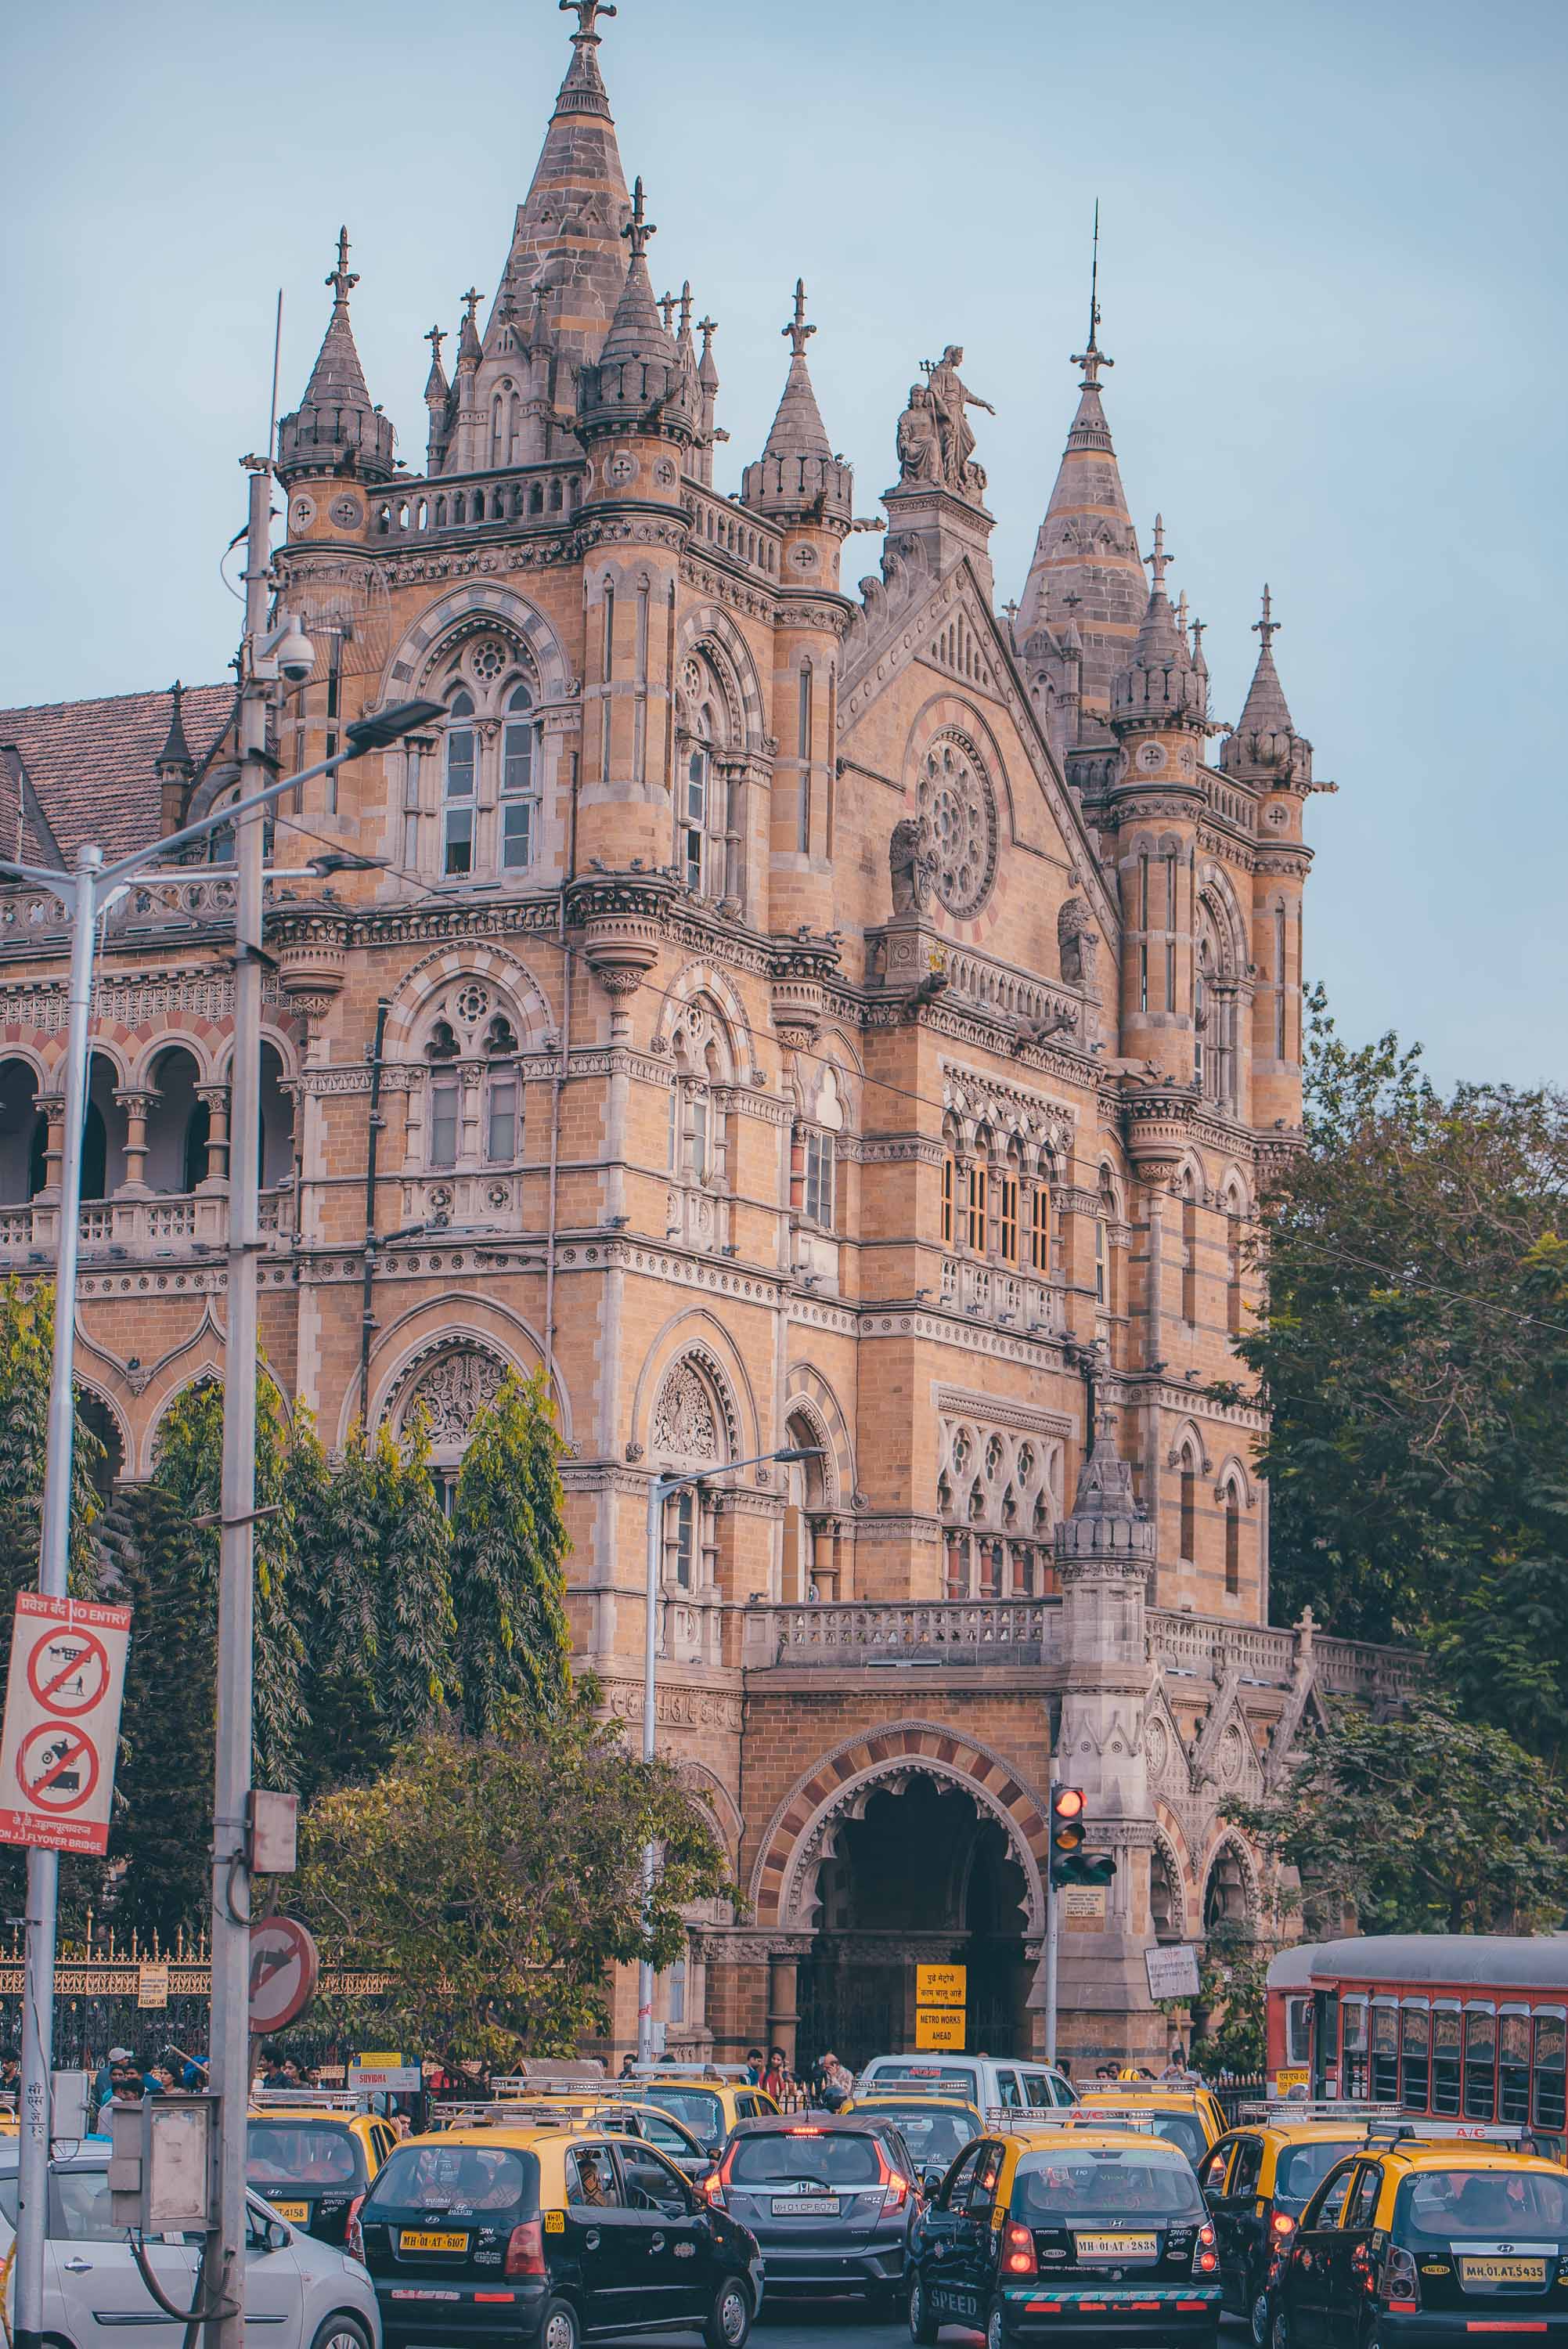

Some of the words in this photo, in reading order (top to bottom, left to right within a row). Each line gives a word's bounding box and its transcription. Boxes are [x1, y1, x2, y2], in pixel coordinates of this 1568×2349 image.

[21, 1595, 47, 1613] प्रवेश
[70, 1607, 87, 1618] NO
[89, 1609, 127, 1626] ENTRY
[69, 1838, 103, 1851] BRIDGE
[921, 2015, 939, 2024] METRO
[941, 2015, 961, 2024] WORKS
[932, 2031, 952, 2040] AHEAD
[359, 2073, 386, 2084] SUVIDHA
[1457, 2127, 1486, 2138] A/C
[1079, 2242, 1094, 2251] MH
[1099, 2242, 1108, 2251] 01
[1112, 2242, 1125, 2251] AT
[1131, 2241, 1155, 2251] 2838
[932, 2289, 977, 2316] SPEED
